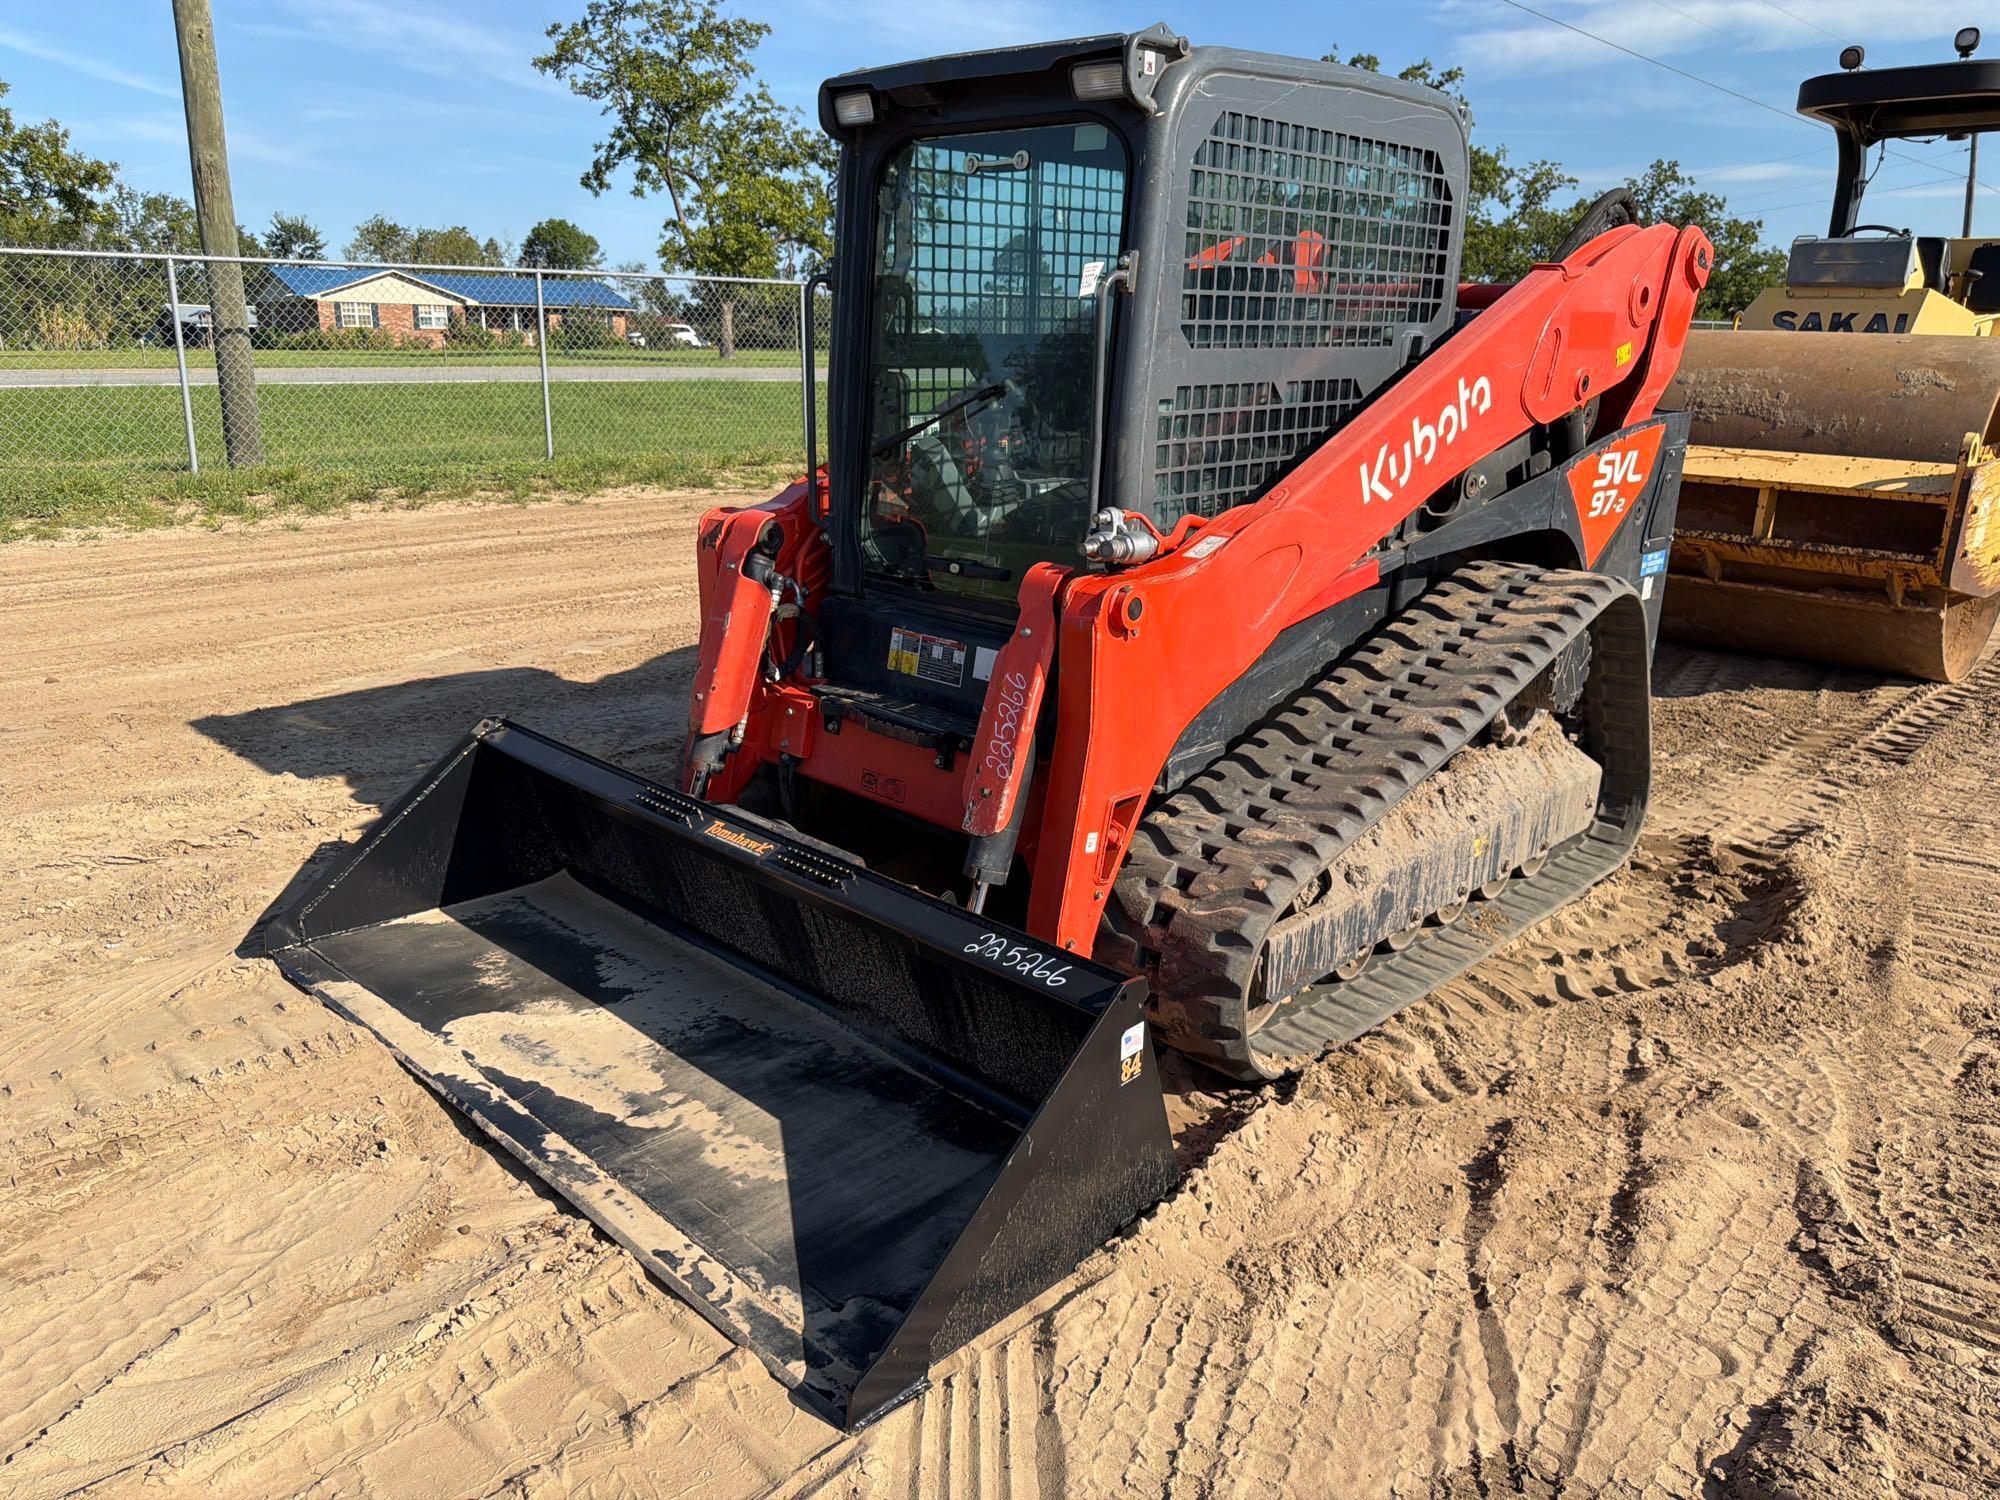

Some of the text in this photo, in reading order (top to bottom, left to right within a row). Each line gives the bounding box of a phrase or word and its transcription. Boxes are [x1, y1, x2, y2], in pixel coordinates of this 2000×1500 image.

[1772, 310, 1909, 334] SAKAI
[1359, 376, 1492, 505] Kubota
[1592, 450, 1643, 489] SVL
[1588, 489, 1626, 519] 97-2
[985, 672, 1027, 779] 225266
[703, 819, 775, 855] Tomahawk
[963, 932, 1073, 987] 225266
[1121, 1051, 1142, 1082] 84
